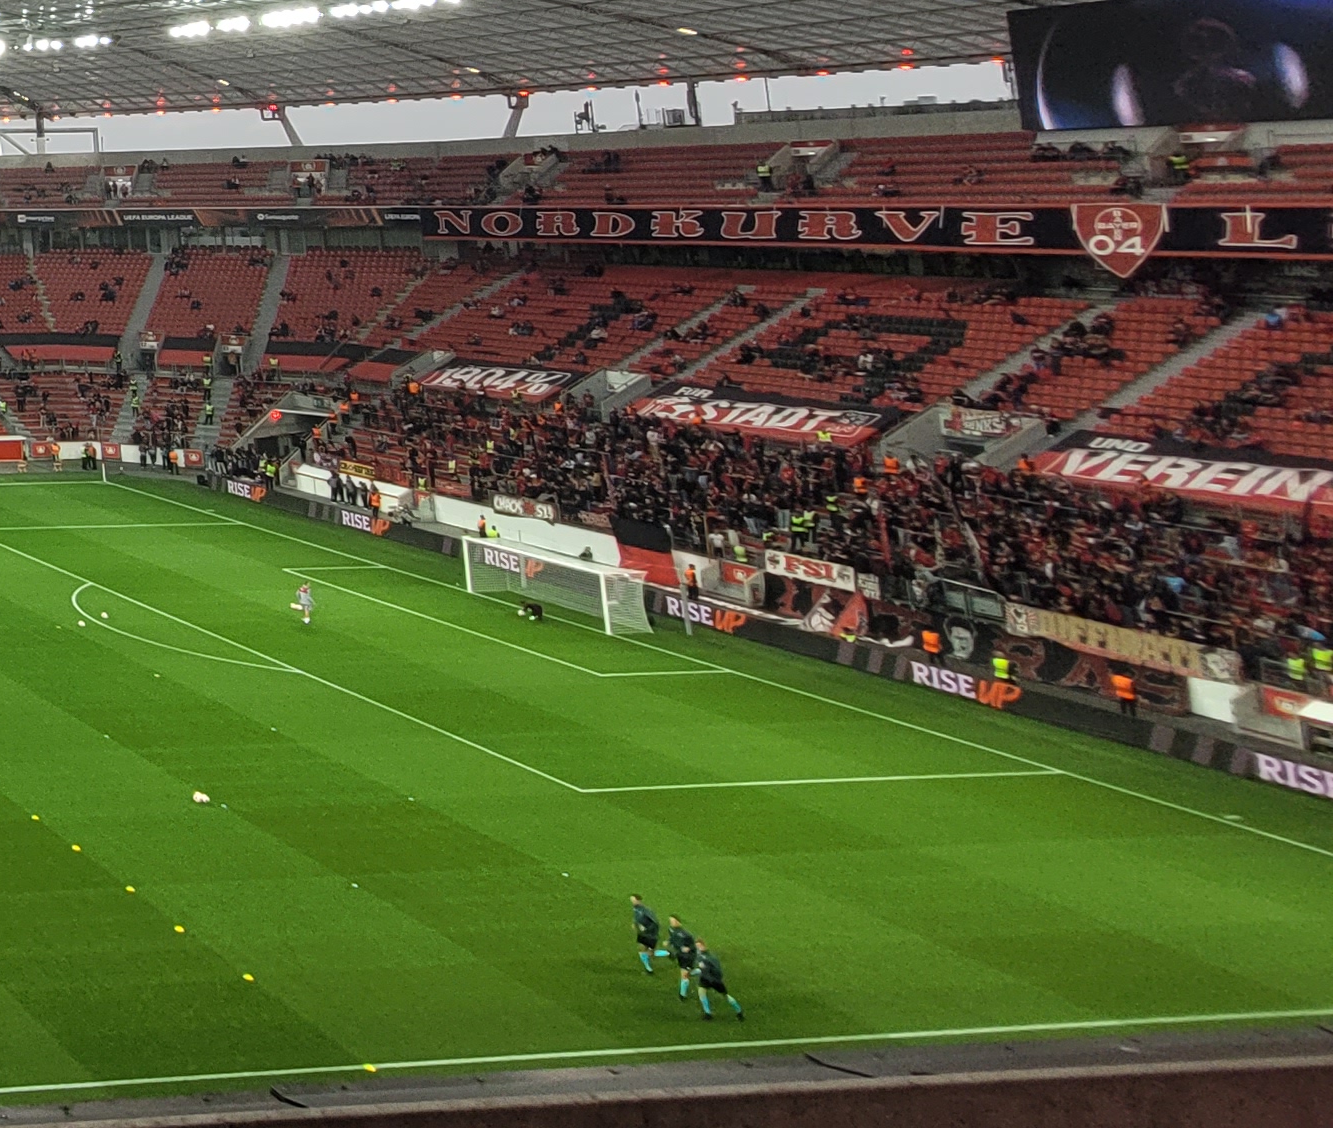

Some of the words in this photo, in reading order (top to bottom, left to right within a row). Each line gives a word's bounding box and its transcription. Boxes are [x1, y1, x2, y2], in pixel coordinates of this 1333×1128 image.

[434, 210, 1034, 245] NORDKURVE
[1088, 235, 1145, 256] 04
[699, 400, 842, 432] STADT
[1088, 437, 1151, 453] UND
[1060, 448, 1333, 502] VEREIN
[227, 480, 251, 498] RISE
[341, 510, 371, 532] RISE
[484, 548, 520, 572] RISE
[714, 610, 746, 633] UP
[912, 661, 976, 699] RISE
[976, 678, 1022, 710] UP
